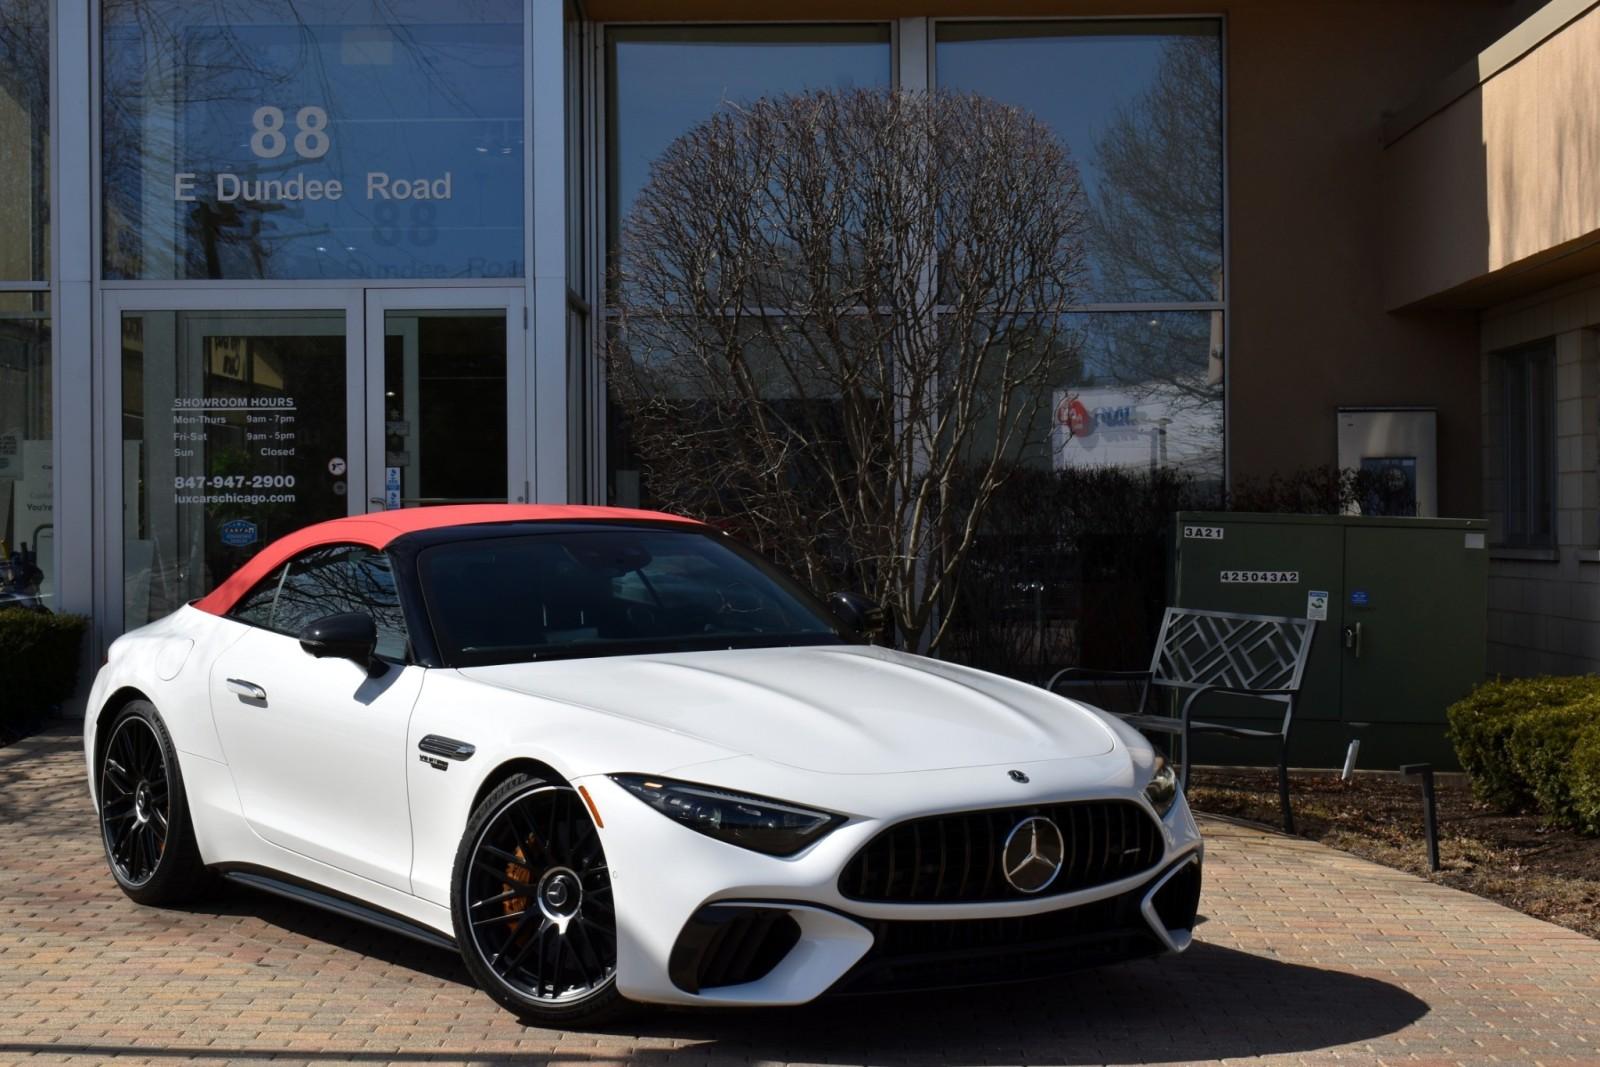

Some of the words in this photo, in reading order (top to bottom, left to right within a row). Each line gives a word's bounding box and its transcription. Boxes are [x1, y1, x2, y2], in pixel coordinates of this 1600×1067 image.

[250, 105, 330, 159] 88
[173, 172, 196, 201] E
[216, 172, 343, 201] Dundee
[366, 171, 451, 201] Road
[174, 397, 248, 408] SHOWROOM
[250, 397, 294, 408] HOURS
[173, 414, 227, 425] Mon-Thurs
[246, 414, 267, 424] 9am
[274, 414, 295, 425] 7pm
[173, 432, 208, 442] Fri-Sat
[246, 432, 267, 441] 9am
[274, 431, 295, 442] 5pm
[173, 448, 194, 457] Sun
[260, 447, 295, 456] Closed
[174, 475, 296, 489] 847-947-2900
[174, 493, 296, 505] luxcarschicago.com
[1184, 526, 1222, 539] 3A21
[1220, 570, 1298, 584] 425043A2
